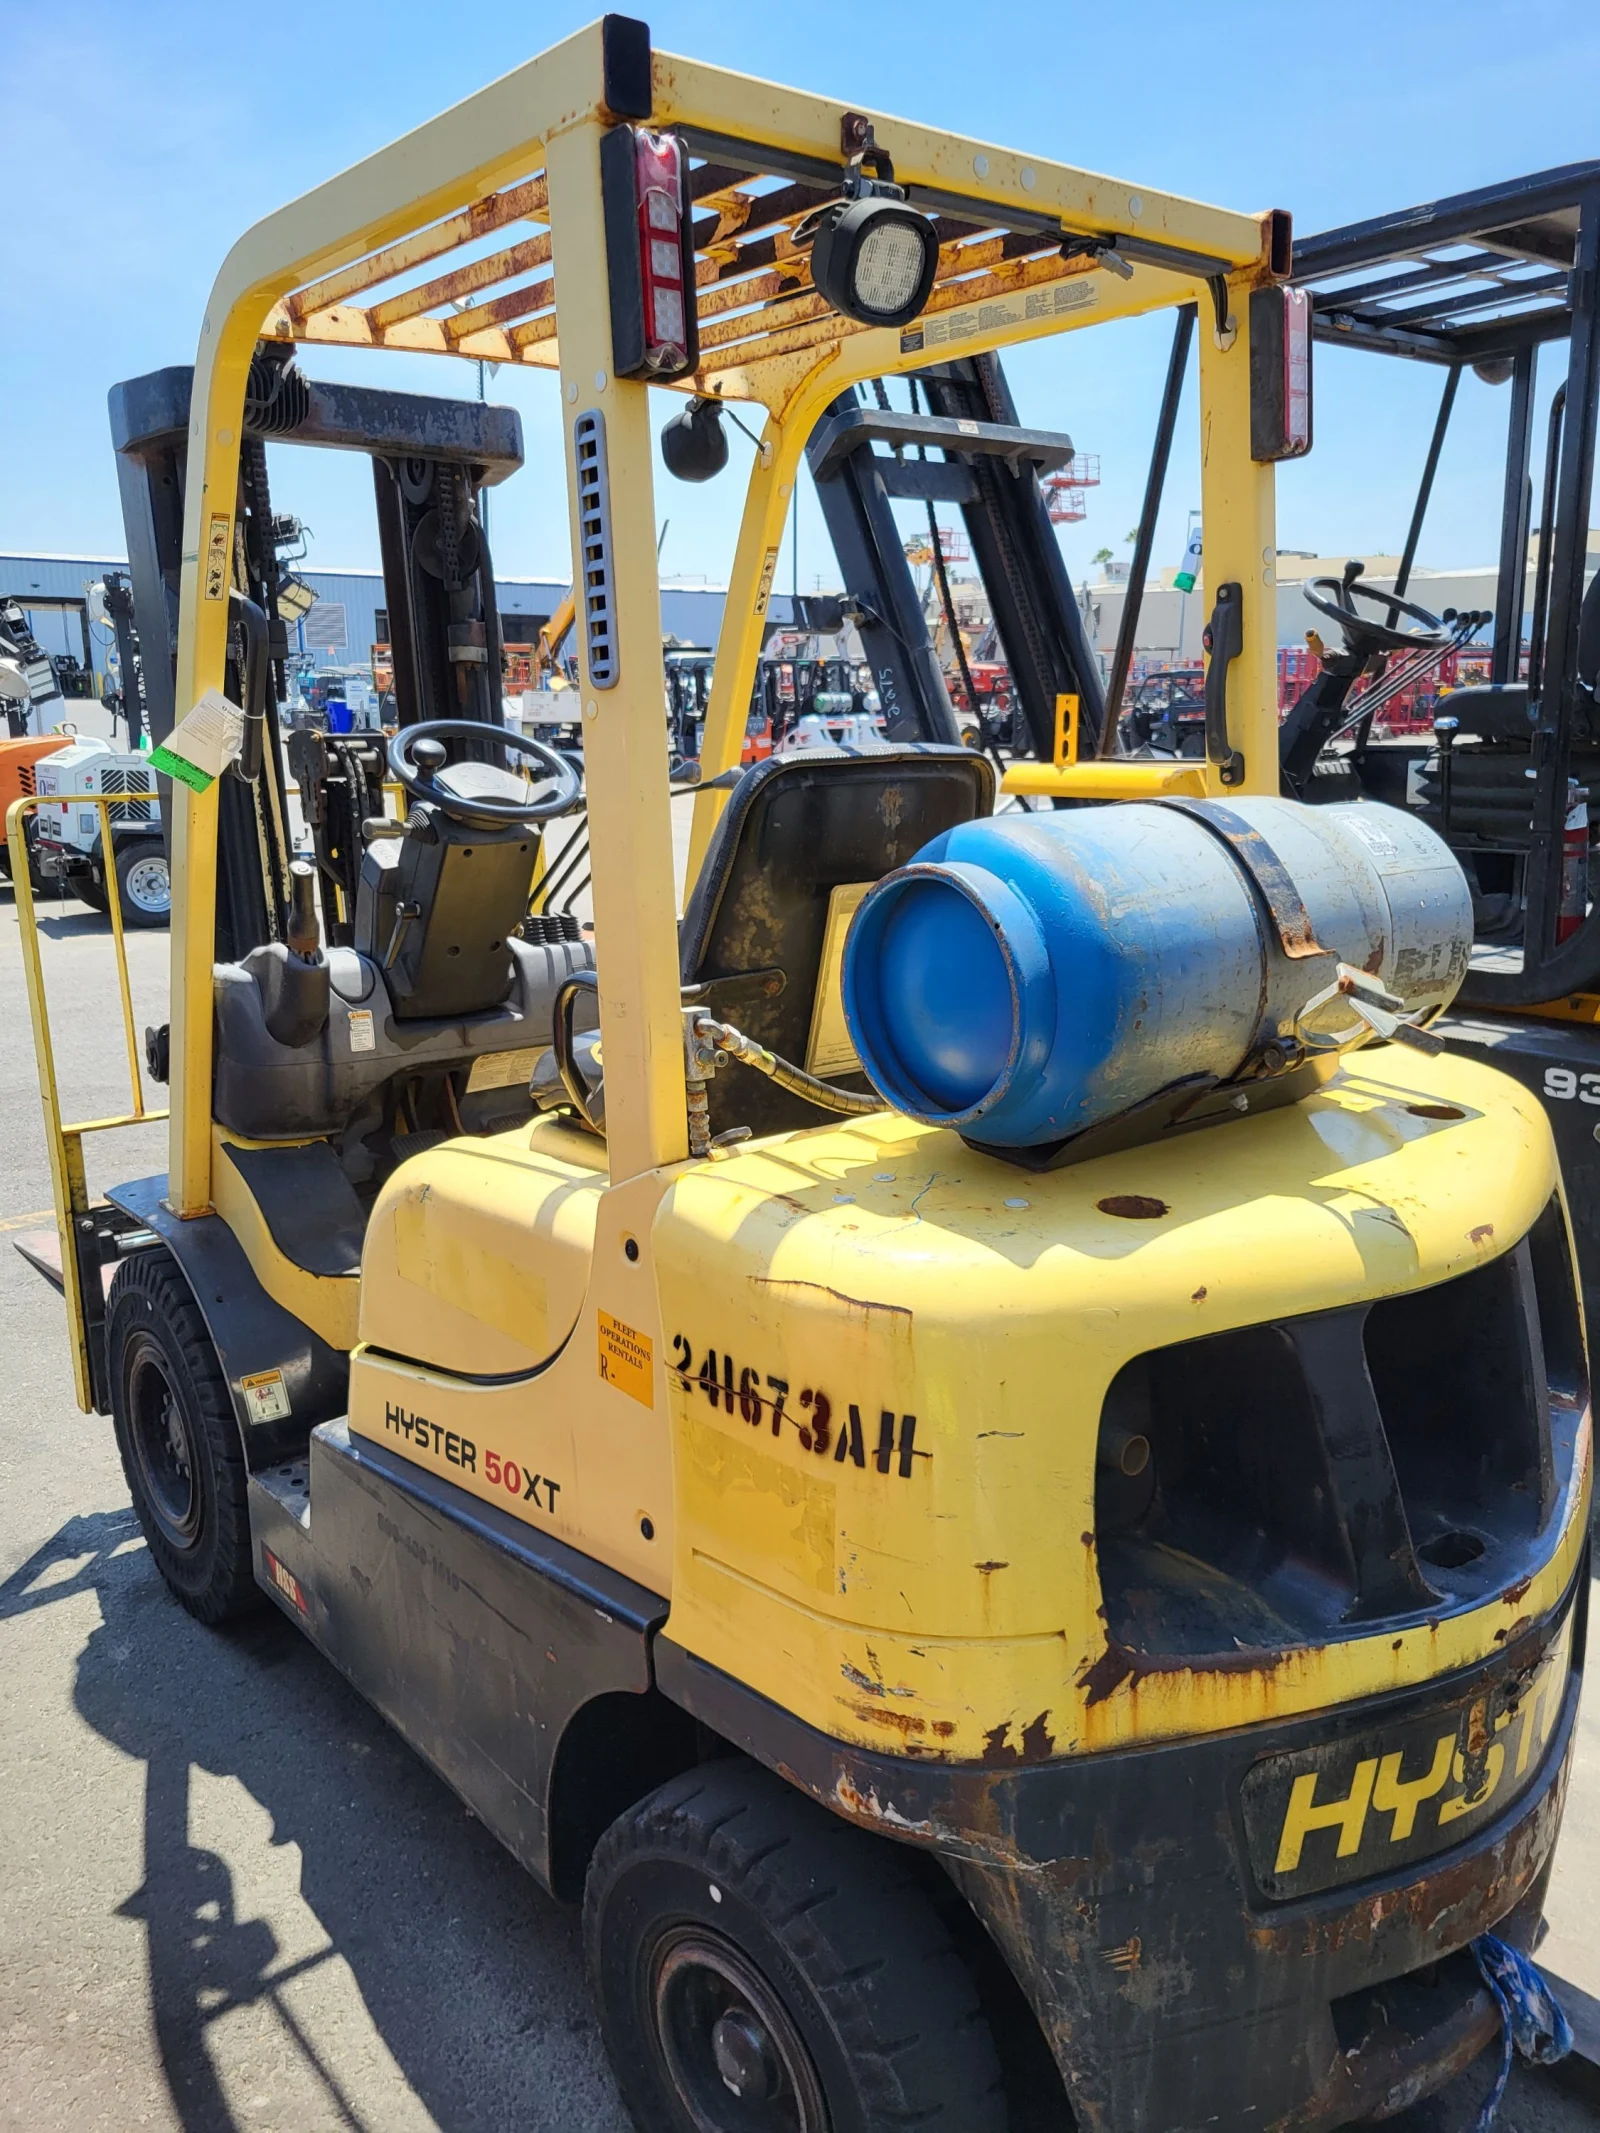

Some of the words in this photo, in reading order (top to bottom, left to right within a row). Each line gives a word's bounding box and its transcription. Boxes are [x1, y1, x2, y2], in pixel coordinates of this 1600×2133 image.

[1543, 1067, 1600, 1106] 93
[600, 1324, 651, 1362] OPERATIONS
[613, 1319, 637, 1340] FLEET
[608, 1341, 643, 1370] RENTALS
[385, 1401, 477, 1474] HYSTER
